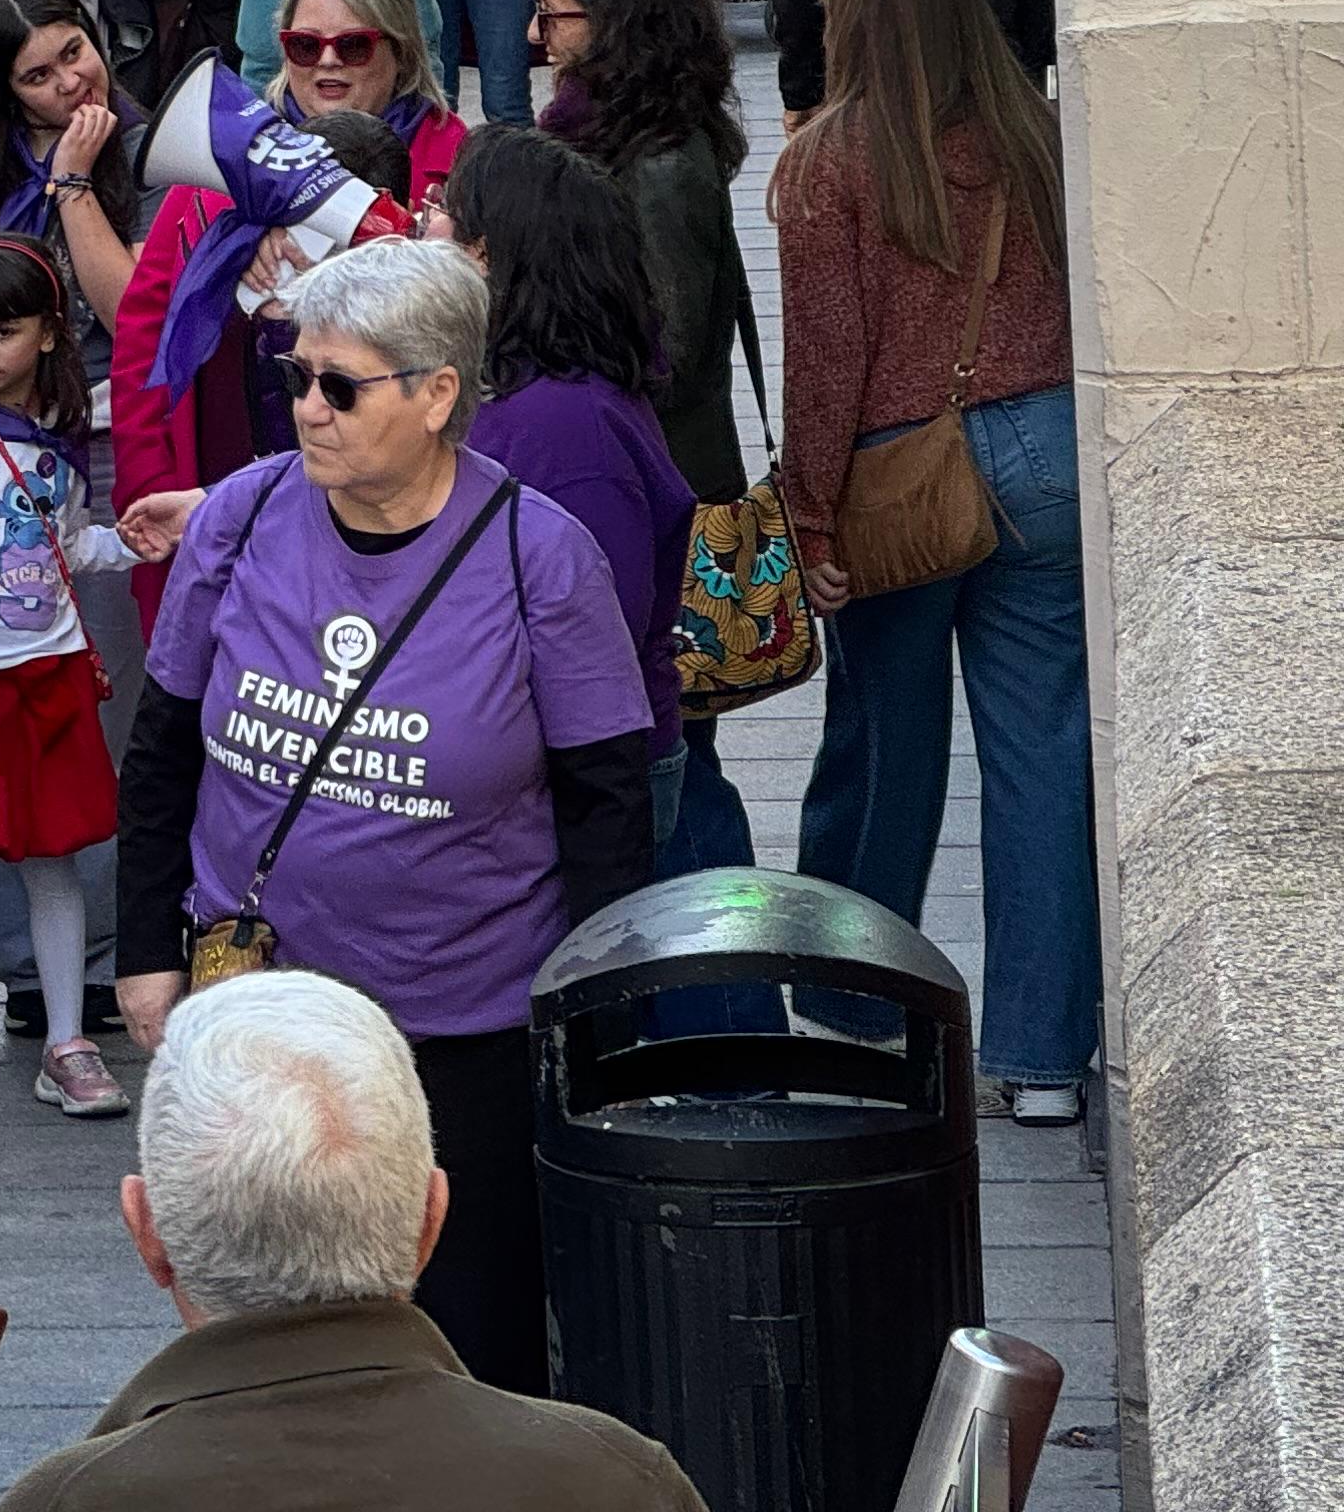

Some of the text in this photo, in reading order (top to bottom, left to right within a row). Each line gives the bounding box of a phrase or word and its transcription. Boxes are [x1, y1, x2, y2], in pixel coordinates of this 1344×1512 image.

[206, 736, 255, 778] CONTRA
[258, 763, 284, 785] EL
[380, 792, 456, 820] GLOBAL
